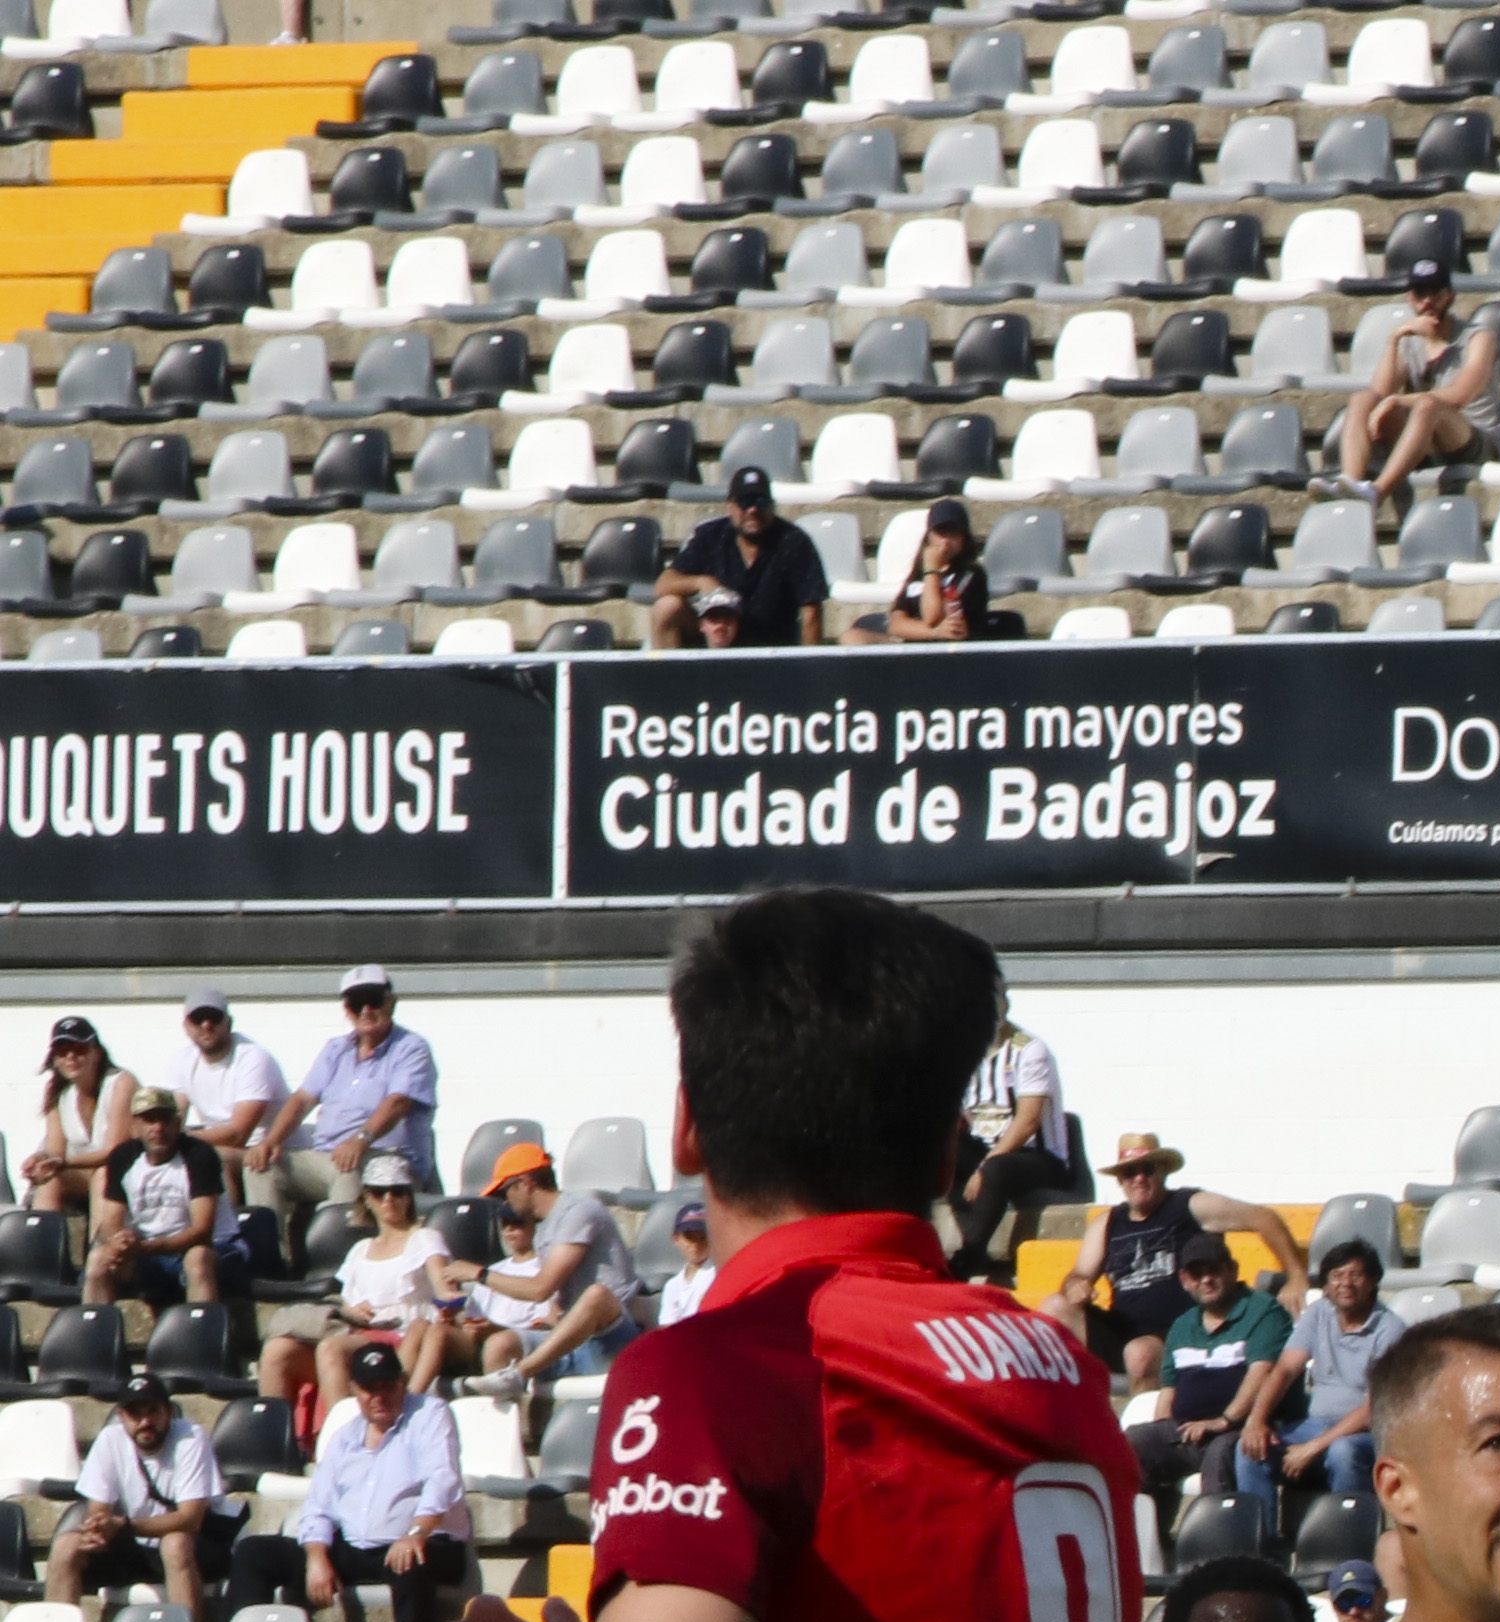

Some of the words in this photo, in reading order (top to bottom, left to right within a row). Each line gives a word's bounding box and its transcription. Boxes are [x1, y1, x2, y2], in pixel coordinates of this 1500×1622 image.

[601, 699, 877, 759] Residencia
[895, 706, 1007, 764] para
[1024, 698, 1244, 760] mayores
[268, 730, 472, 834] HOUSE
[601, 770, 851, 851] Ciudad
[876, 776, 960, 846] de
[986, 765, 1277, 857] Badajoz
[1388, 818, 1488, 845] Cuidamos
[914, 1313, 1082, 1386] JUANJO
